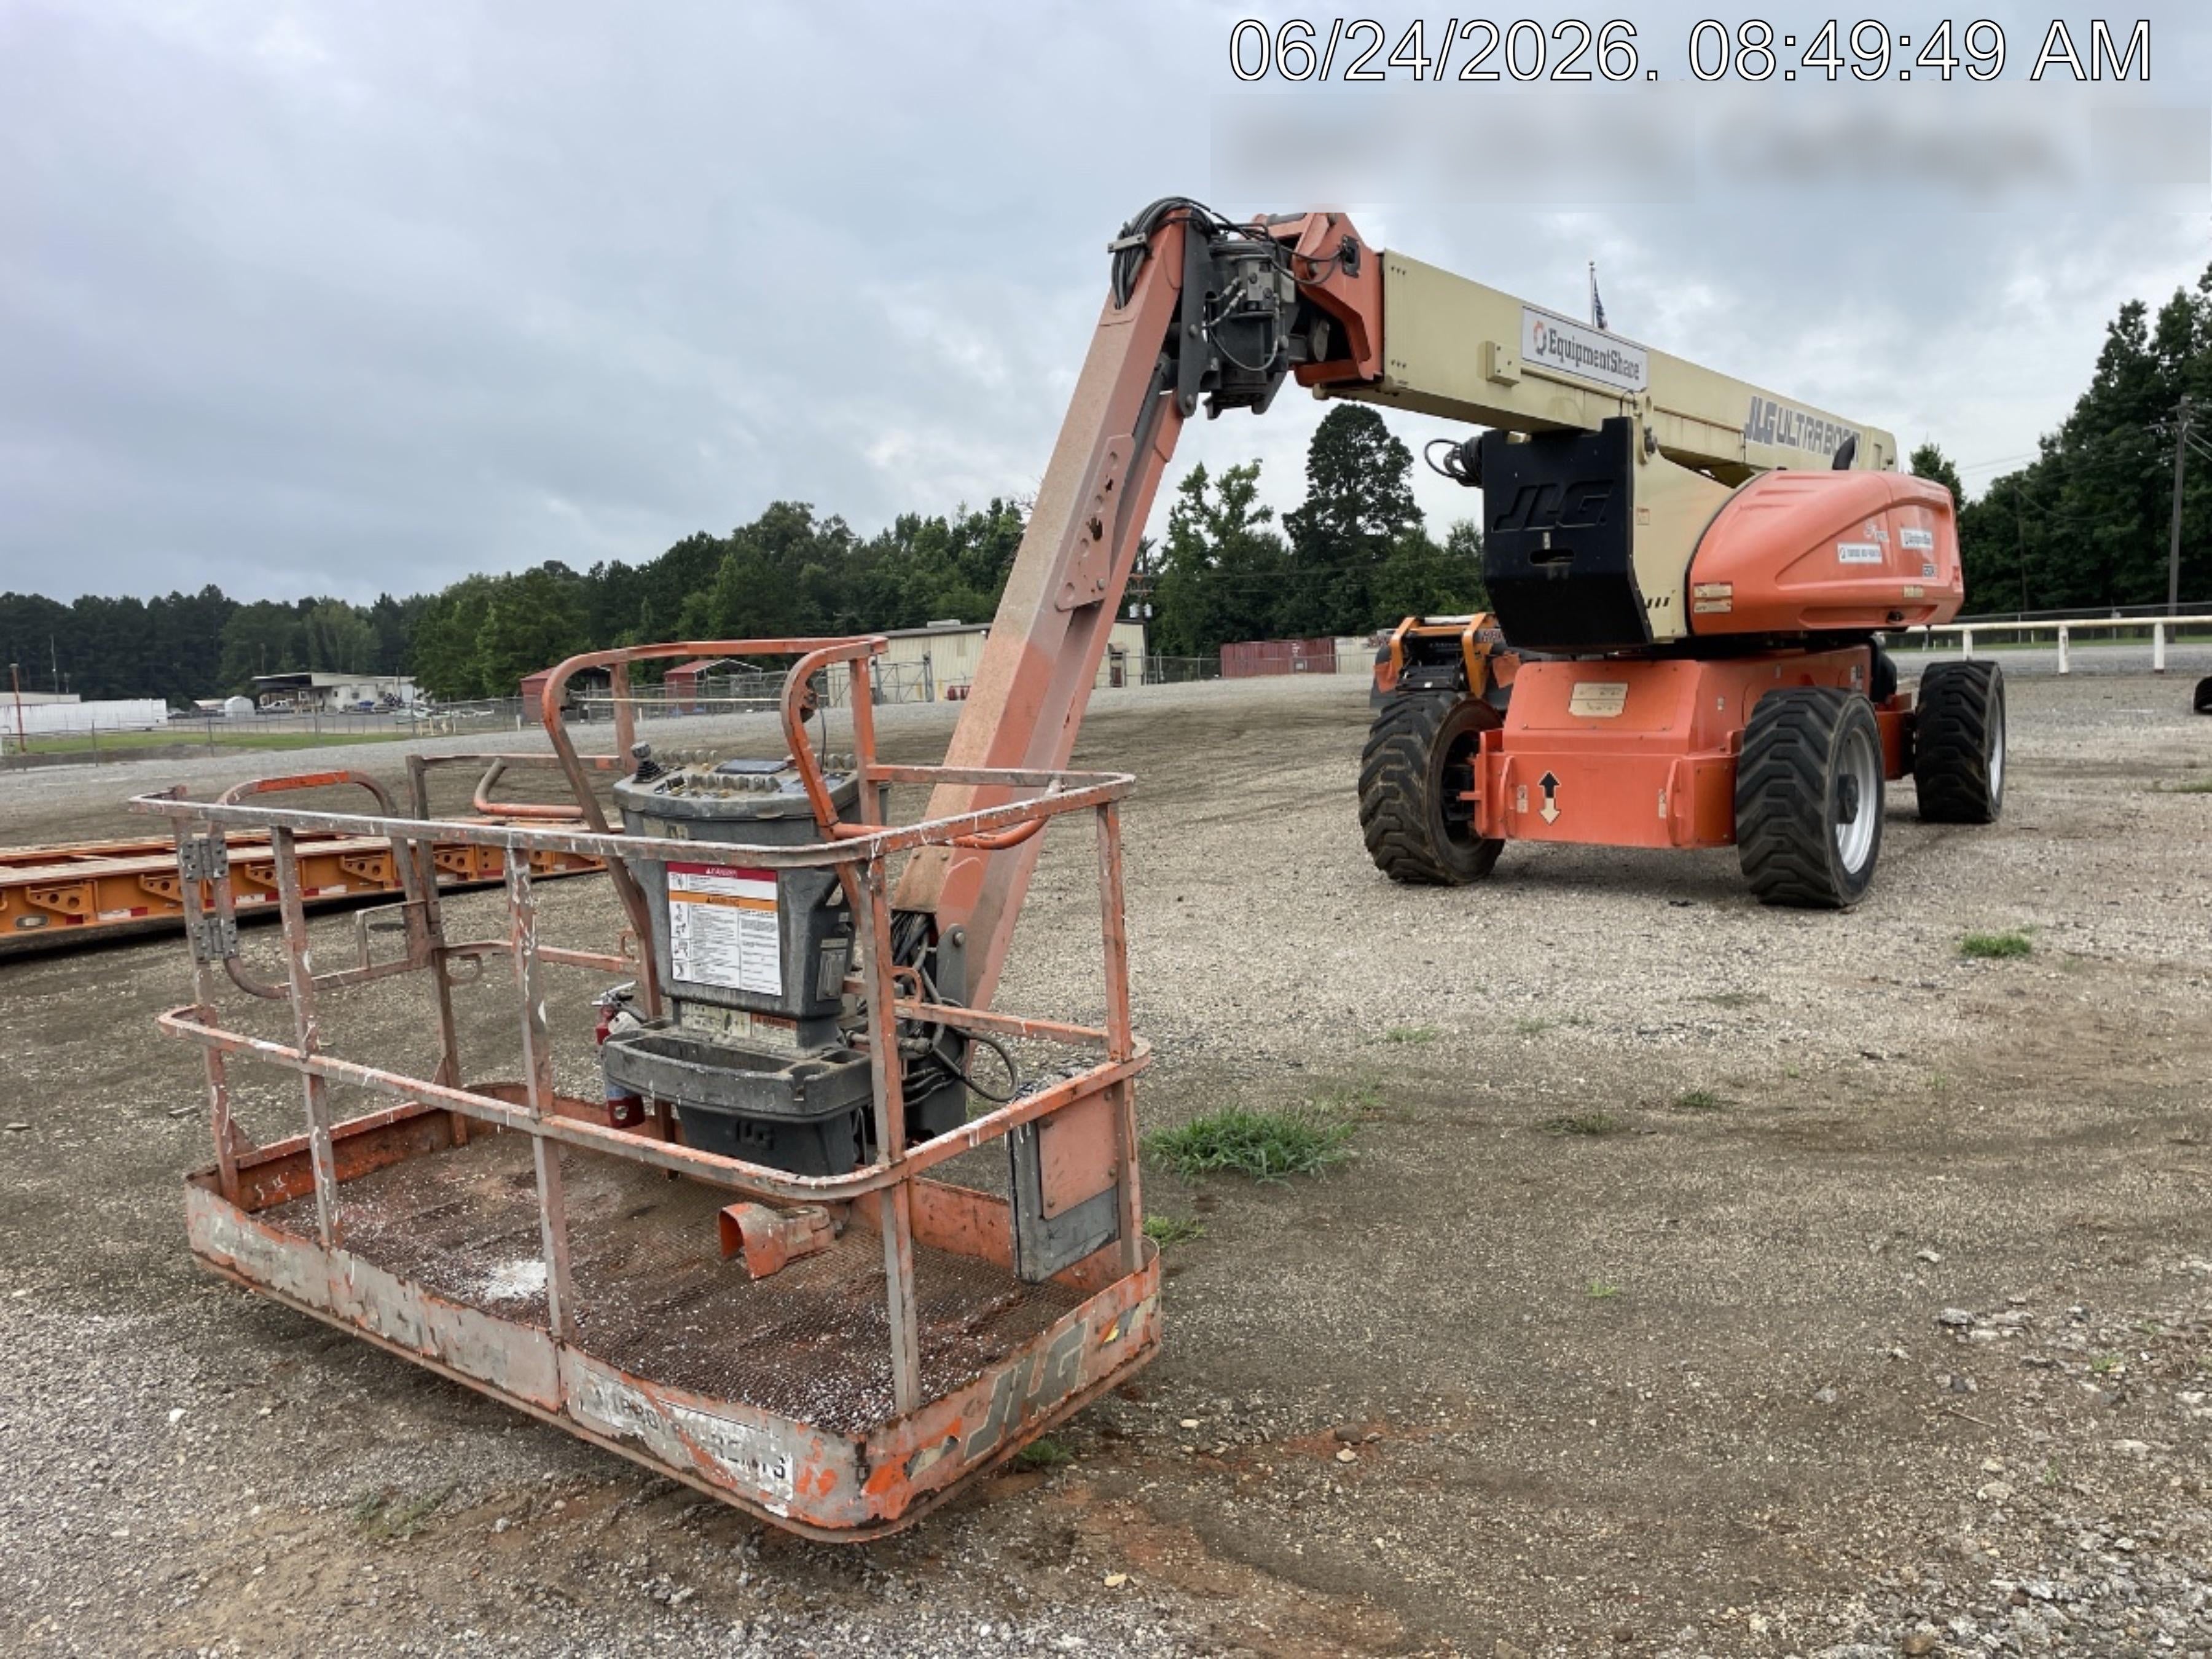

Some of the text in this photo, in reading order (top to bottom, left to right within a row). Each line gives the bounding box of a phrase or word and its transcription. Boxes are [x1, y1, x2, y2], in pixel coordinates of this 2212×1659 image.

[1548, 327, 1639, 380] EquipmentShare
[1745, 396, 1778, 445] JLG
[1492, 479, 1615, 533] JLG
[964, 1317, 1089, 1466] JLG
